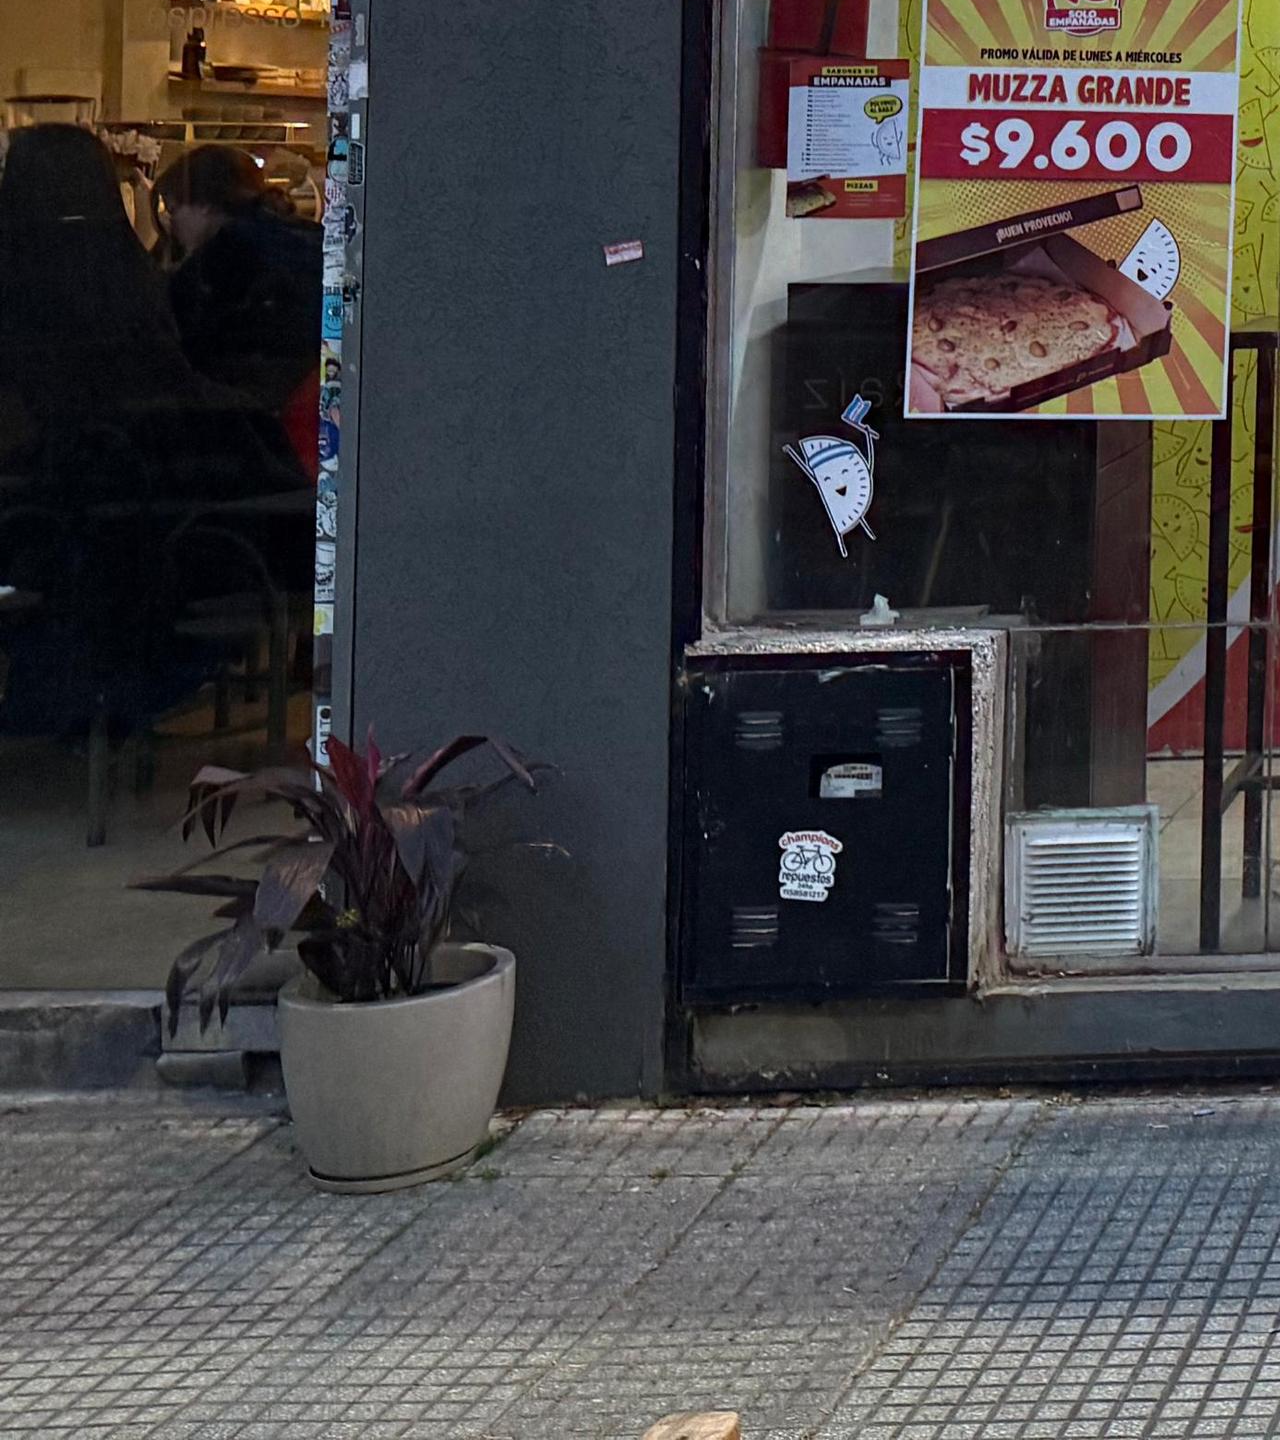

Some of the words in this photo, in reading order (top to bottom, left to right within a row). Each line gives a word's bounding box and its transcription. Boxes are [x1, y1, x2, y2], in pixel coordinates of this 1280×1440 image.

[1049, 16, 1116, 27] EMPANADAS
[1068, 10, 1098, 19] SOLO
[980, 48, 1018, 60] PROMO
[1021, 46, 1060, 61] VÁLIDA
[1062, 49, 1076, 61] DE
[1079, 50, 1112, 62] LUNES
[1115, 51, 1122, 62] A
[1125, 49, 1182, 63] MIÉRCOLES
[813, 76, 886, 86] EMPANADAS
[968, 73, 1068, 104] MUZZA
[1077, 75, 1192, 106] GRANDE
[960, 118, 1192, 173] $9.600
[781, 833, 840, 851] champions
[781, 872, 832, 885] repuestos
